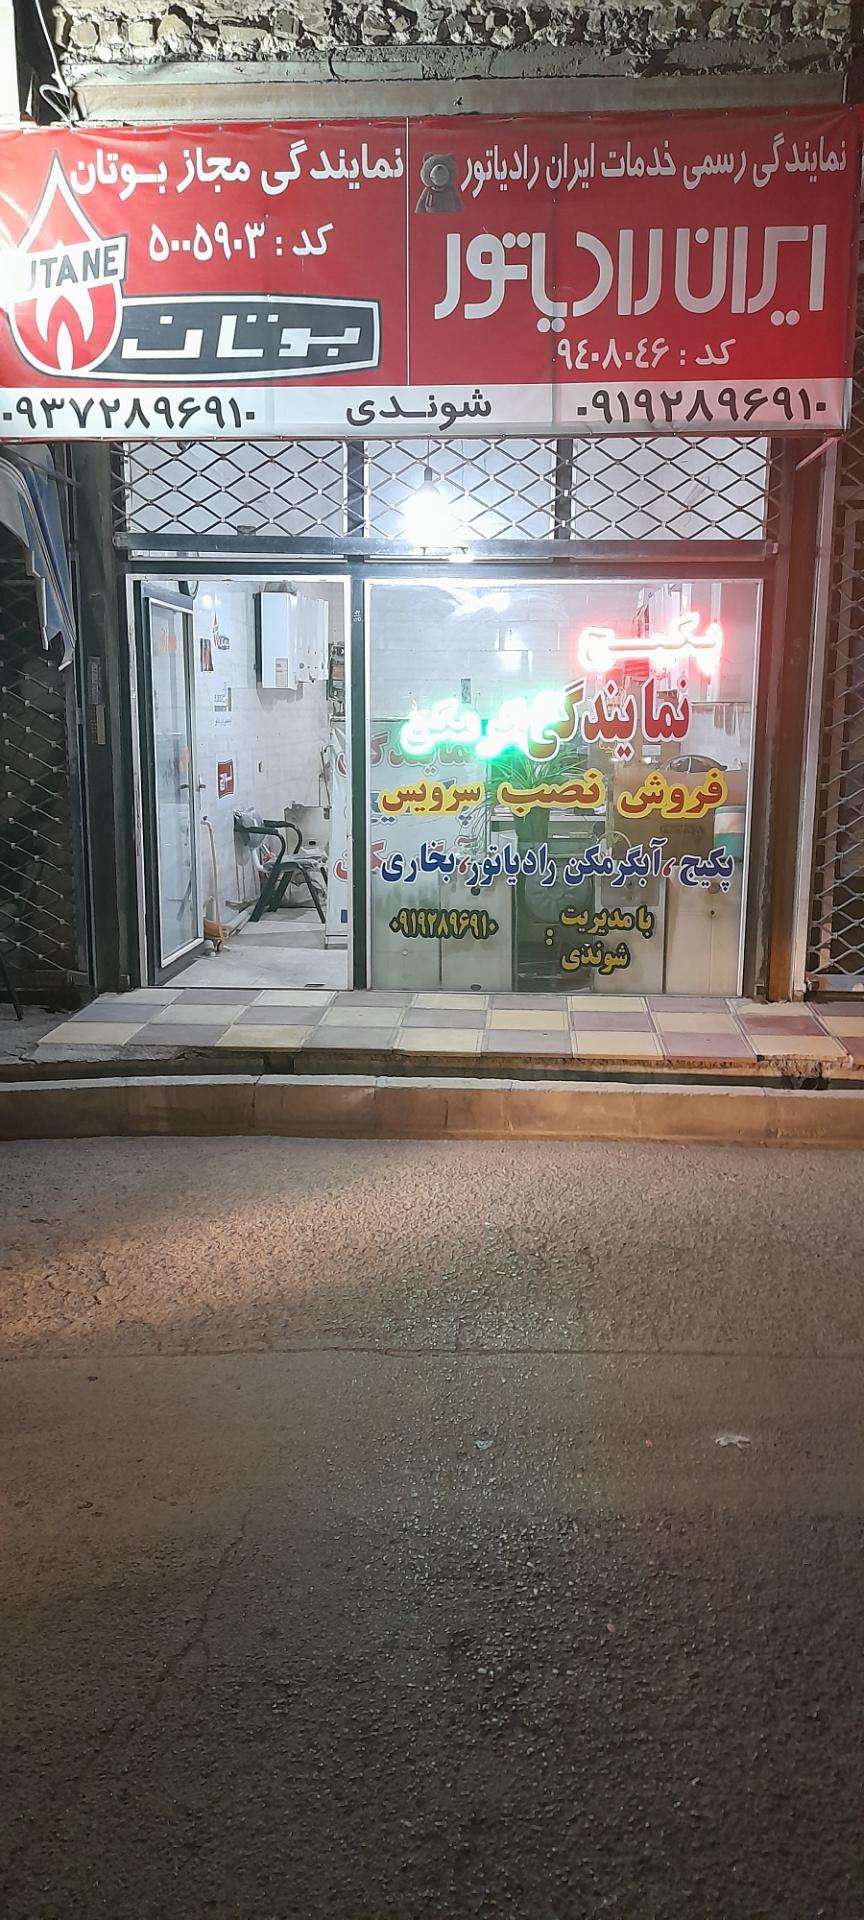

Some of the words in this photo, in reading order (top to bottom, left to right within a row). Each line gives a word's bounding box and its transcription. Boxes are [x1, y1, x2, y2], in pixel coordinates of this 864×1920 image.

[70, 148, 168, 201] بوتان
[176, 147, 251, 194] مجاز
[460, 143, 541, 199] رادیاتور
[545, 142, 596, 192] ایران
[600, 140, 677, 178] خدمات
[683, 150, 747, 191] رسمی
[753, 132, 848, 188] نمایندگی
[291, 223, 334, 257] کد
[434, 228, 663, 333] رادیاتور
[674, 225, 828, 326] ایران
[120, 312, 362, 360] بوتان
[695, 338, 737, 365] کد
[1, 395, 256, 430] ۰۹۳۷۲۸۹۶۹۱۰
[577, 386, 827, 425] ۰۹۱۹۲۸۹۶۹۱۰
[379, 778, 482, 818] سرویس
[497, 768, 605, 816] نصب
[617, 768, 728, 819] فروش
[381, 840, 457, 885] بخاری
[389, 907, 500, 940] ۰۹۱۹۲۸۹۶۹۱۰
[560, 906, 635, 937] مدیریت
[635, 904, 656, 940] با
[560, 942, 632, 976] شوندی
